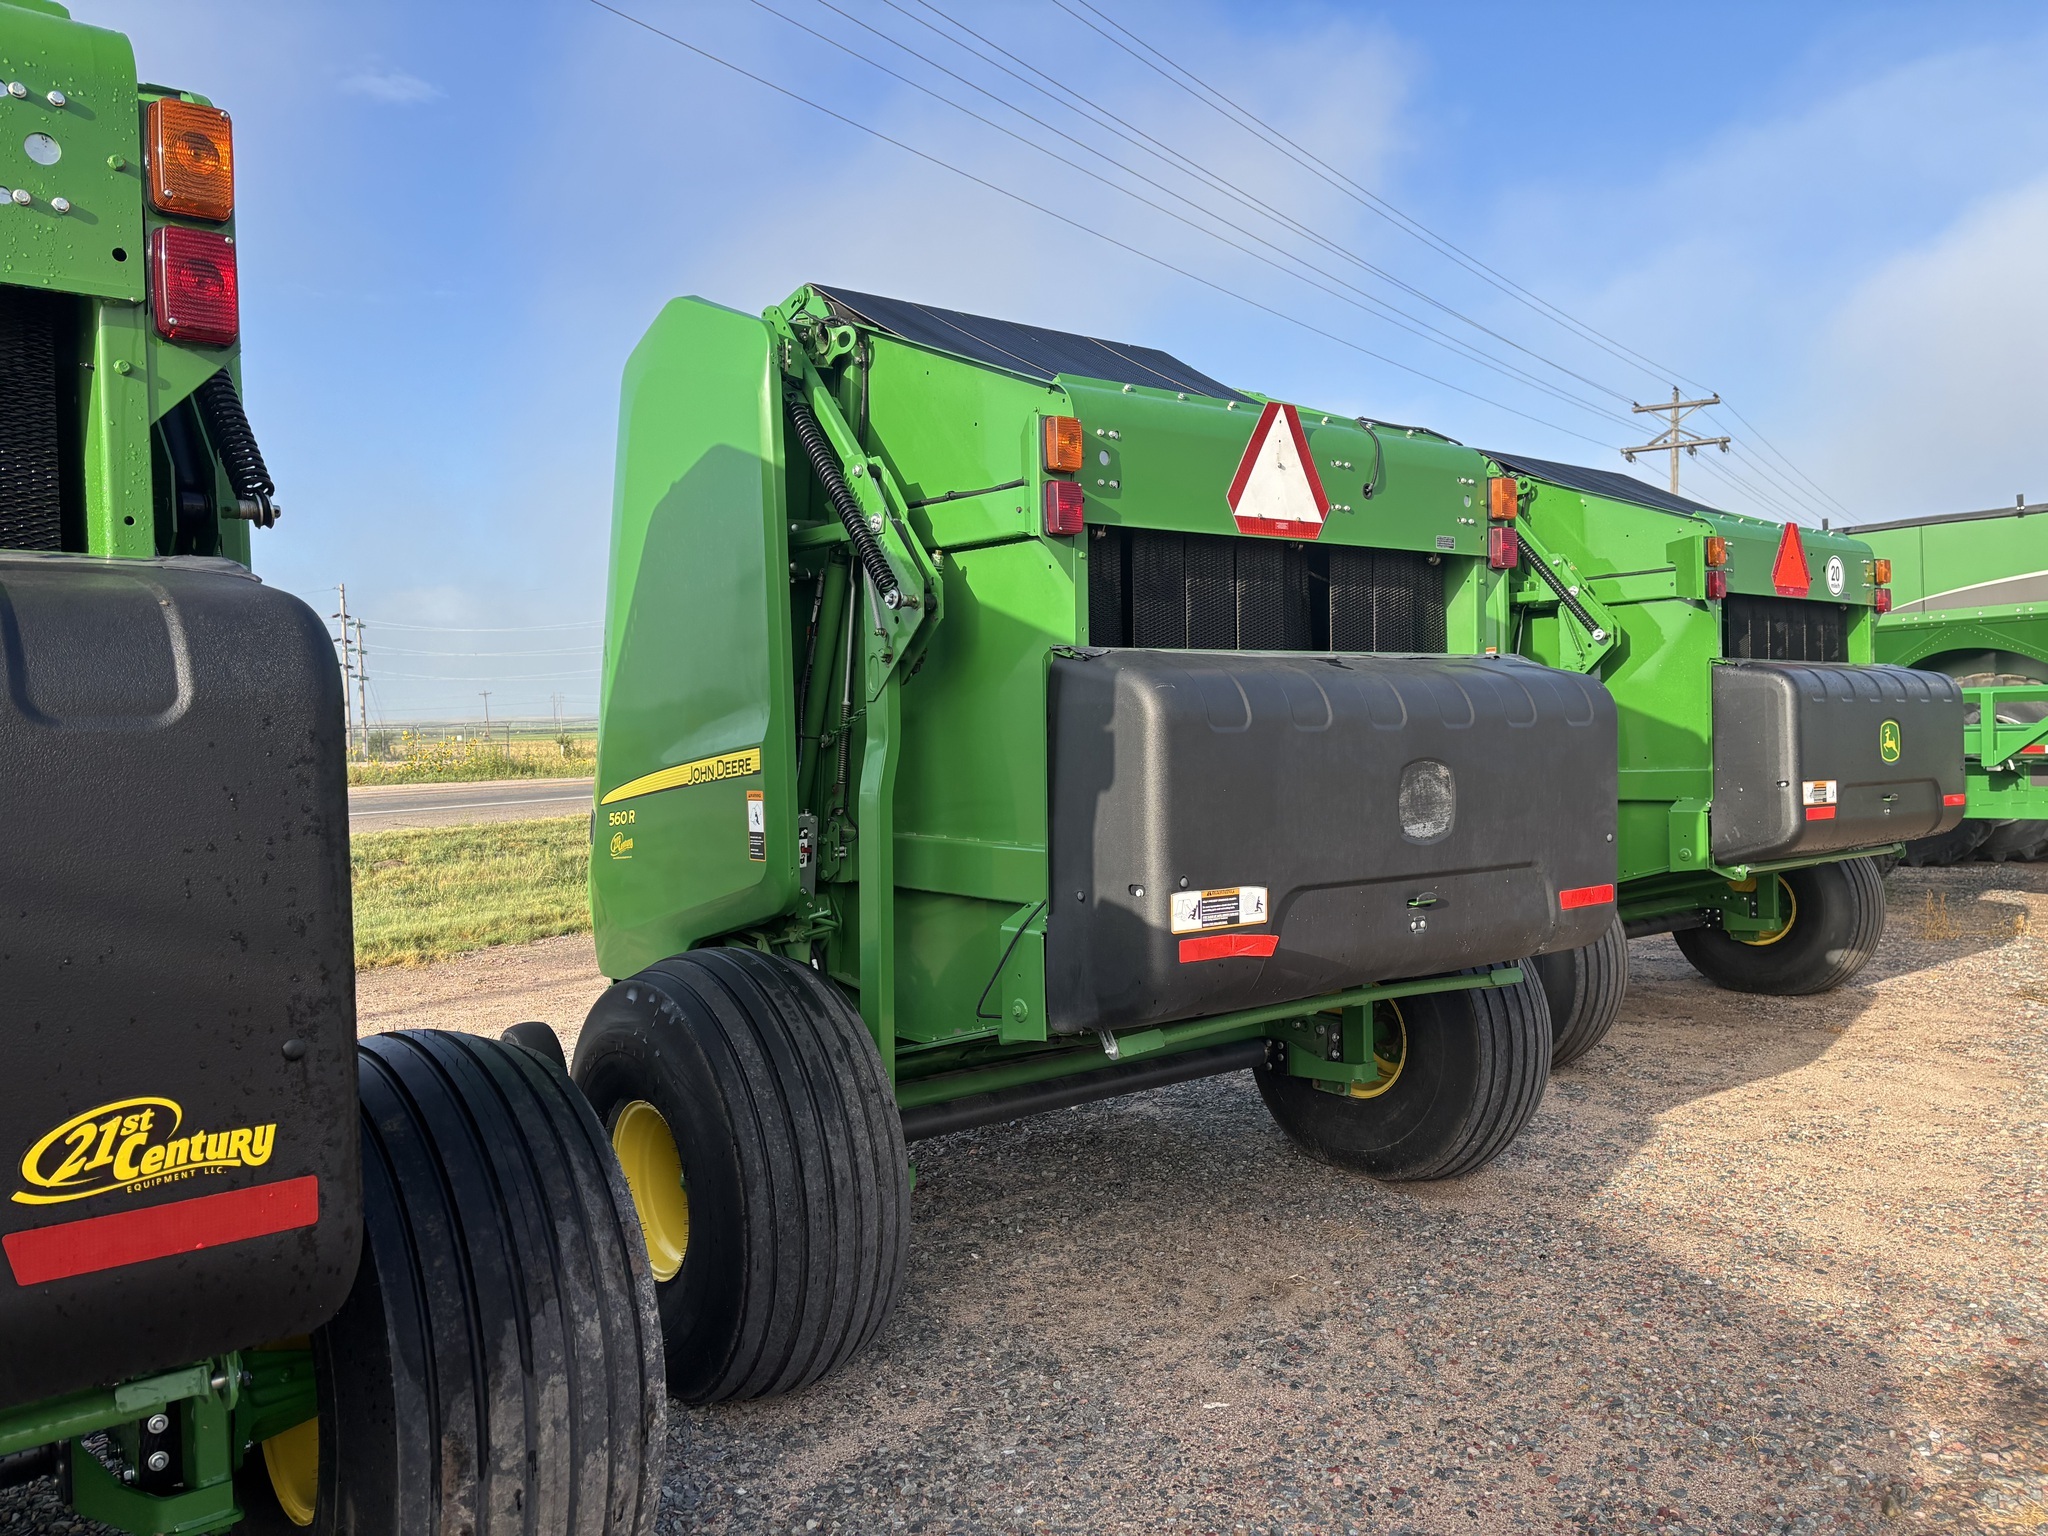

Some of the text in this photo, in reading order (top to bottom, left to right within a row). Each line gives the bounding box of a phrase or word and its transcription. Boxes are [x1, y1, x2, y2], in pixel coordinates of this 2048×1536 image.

[1831, 565, 1840, 582] 20
[687, 758, 753, 784] JOHN DEERE
[46, 1108, 155, 1188] 21st
[126, 1169, 196, 1194] EQUIPMENT
